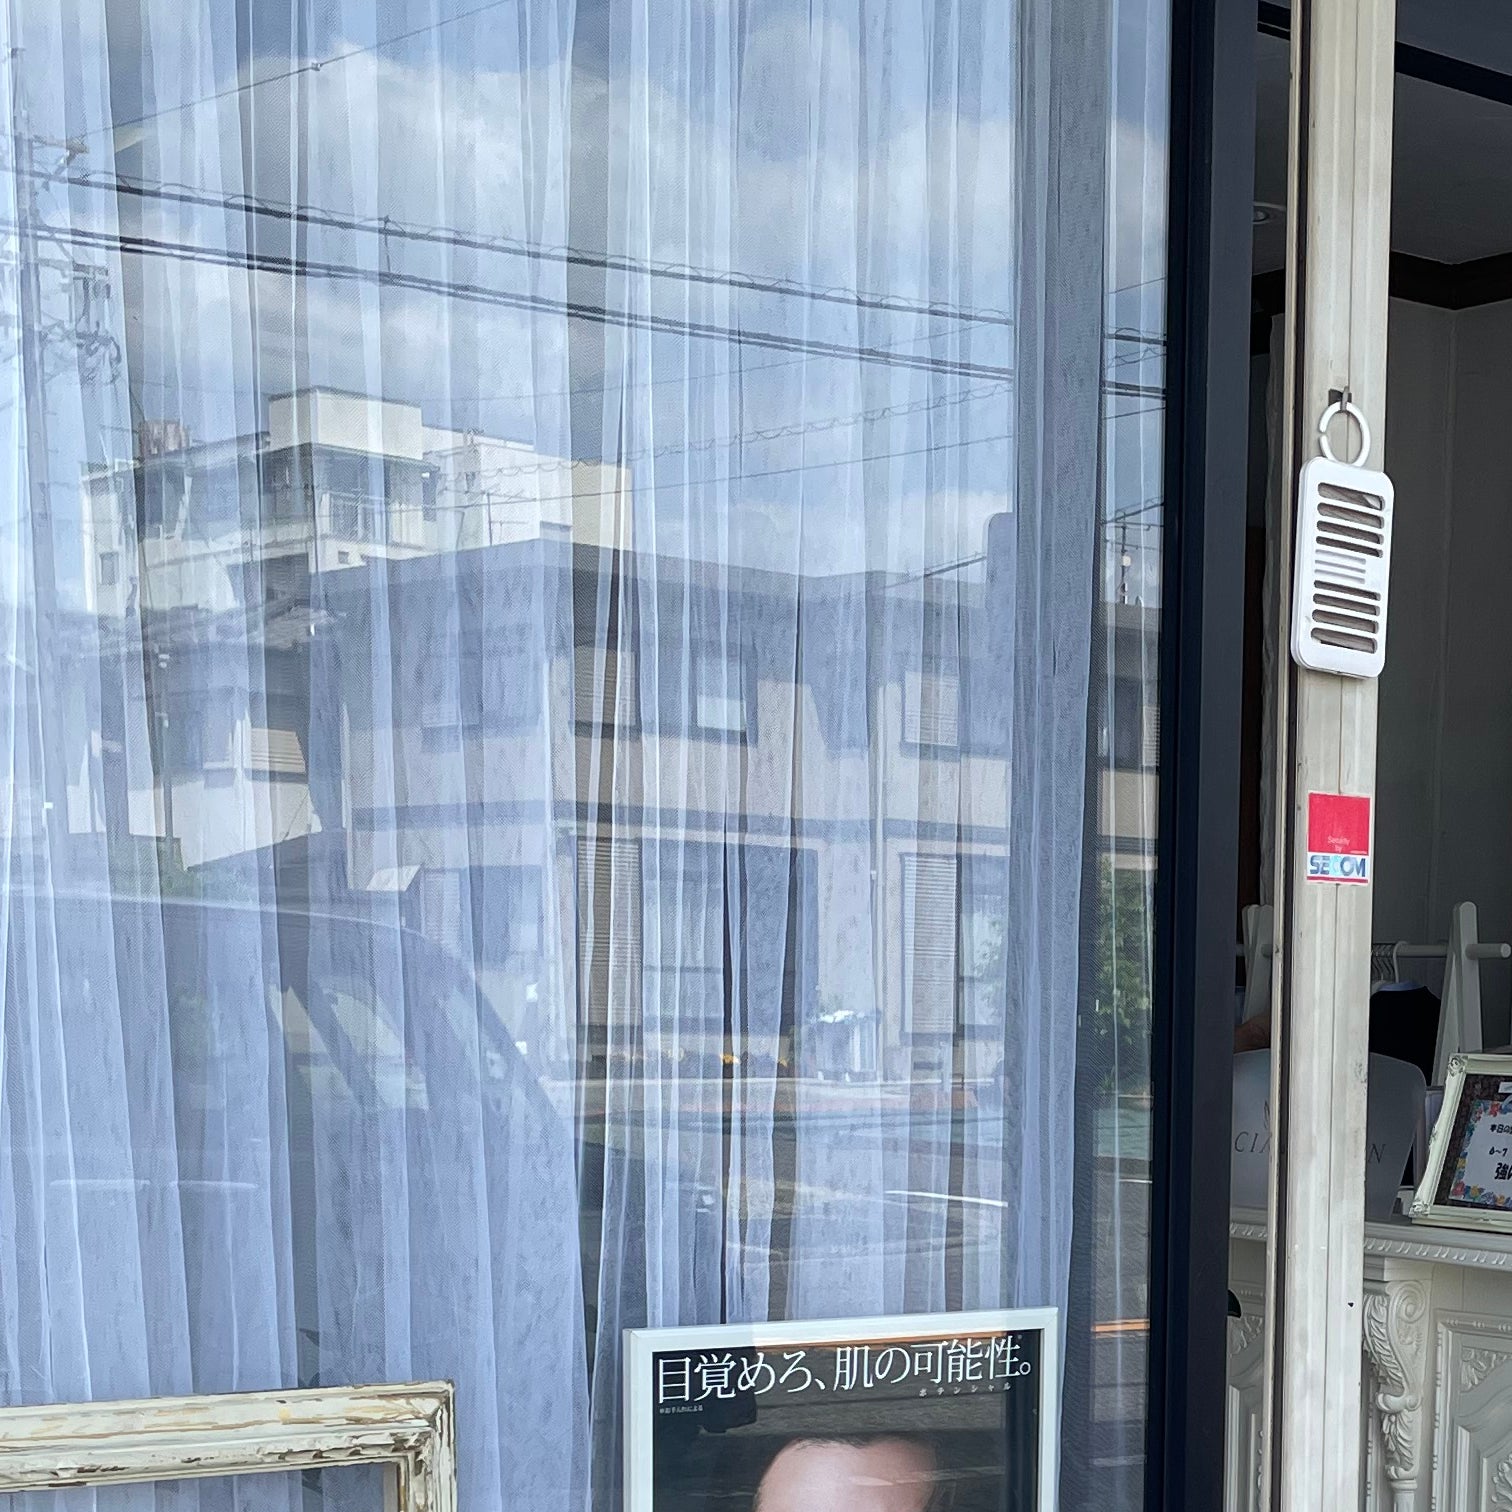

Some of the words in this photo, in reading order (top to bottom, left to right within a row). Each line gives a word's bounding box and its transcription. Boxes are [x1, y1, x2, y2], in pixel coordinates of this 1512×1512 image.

[1309, 854, 1366, 877] SECOM
[657, 1335, 1032, 1404] 目覚めろ、肌の可能性。
